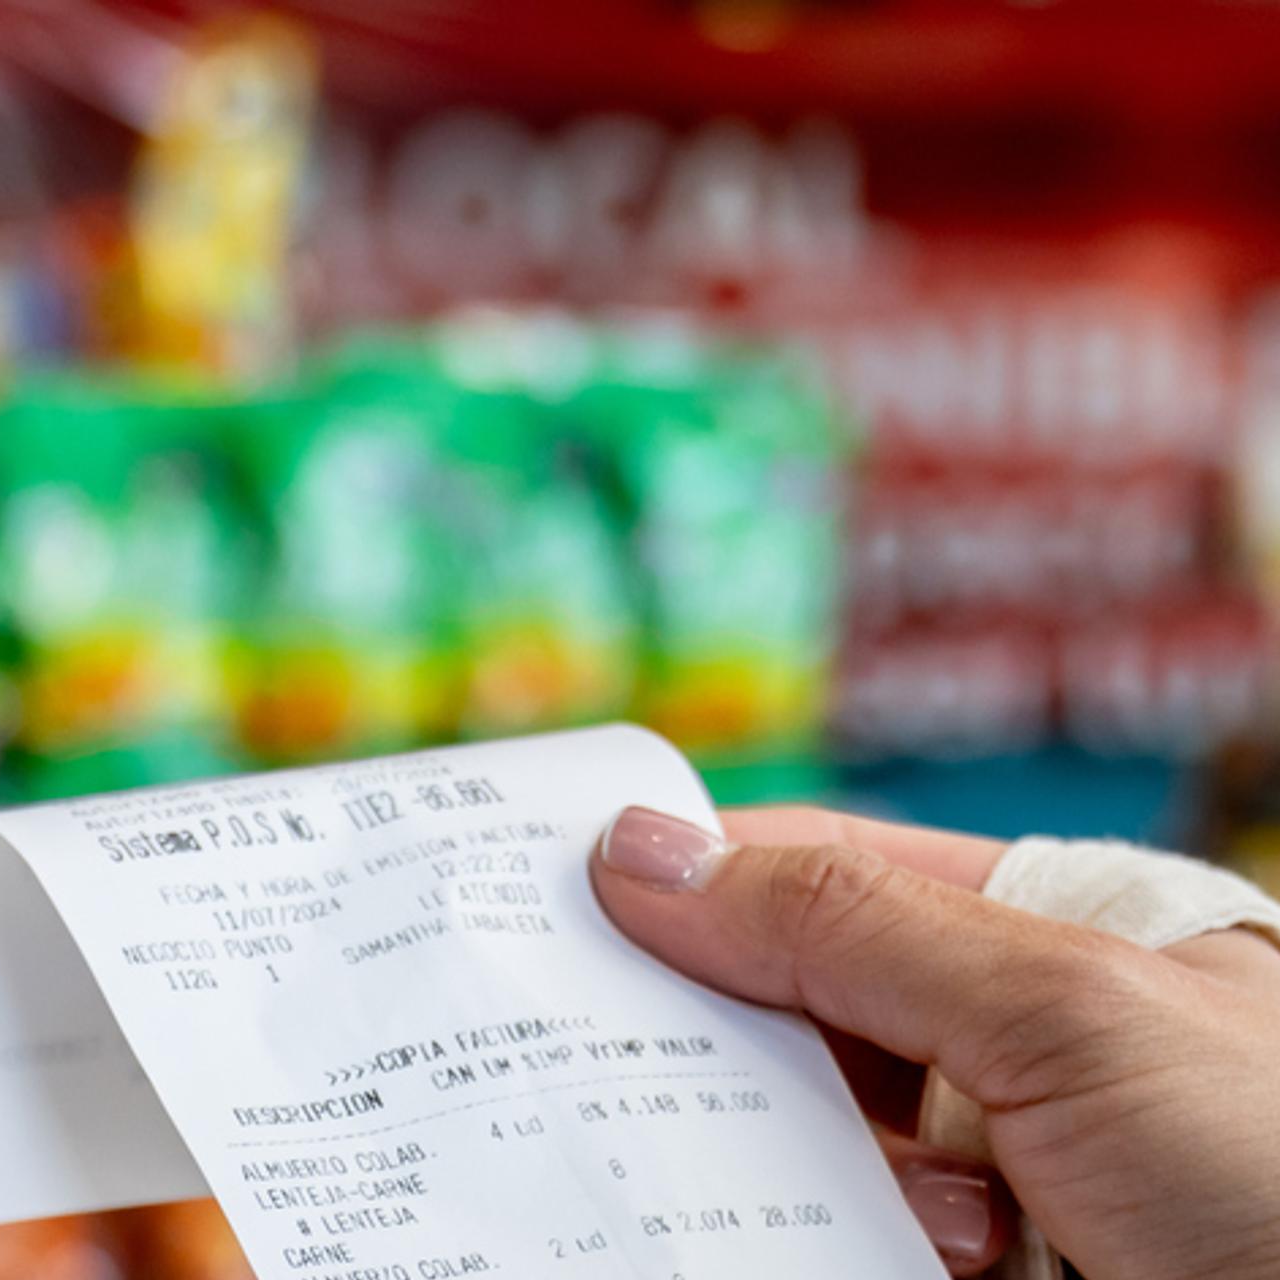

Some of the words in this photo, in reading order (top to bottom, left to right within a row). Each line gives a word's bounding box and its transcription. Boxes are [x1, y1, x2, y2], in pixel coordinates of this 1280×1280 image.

[98, 827, 202, 862] Sistema
[159, 883, 227, 905] FECHA
[235, 881, 250, 898] Y
[262, 876, 316, 897] HORA
[323, 867, 353, 888] DE
[363, 836, 457, 875] EMISION
[213, 897, 342, 931] 11/07/2024
[122, 940, 216, 964] NEGOCIO
[224, 935, 293, 959] PUNTO
[265, 964, 280, 983] 1
[342, 919, 451, 964] SAMANTHA
[233, 1089, 385, 1127] DESCRIPCION
[431, 1063, 477, 1090] CAN
[652, 1036, 719, 1056] VALOR
[241, 1156, 348, 1182] ALMUERZO
[355, 1142, 439, 1172] COLAB.
[254, 1173, 429, 1210] LENTEJA-CARNE
[321, 1206, 419, 1235] LENTEJA
[283, 1243, 355, 1269] CARNE
[418, 1252, 501, 1280] COLAB.
[548, 1238, 566, 1259] 2
